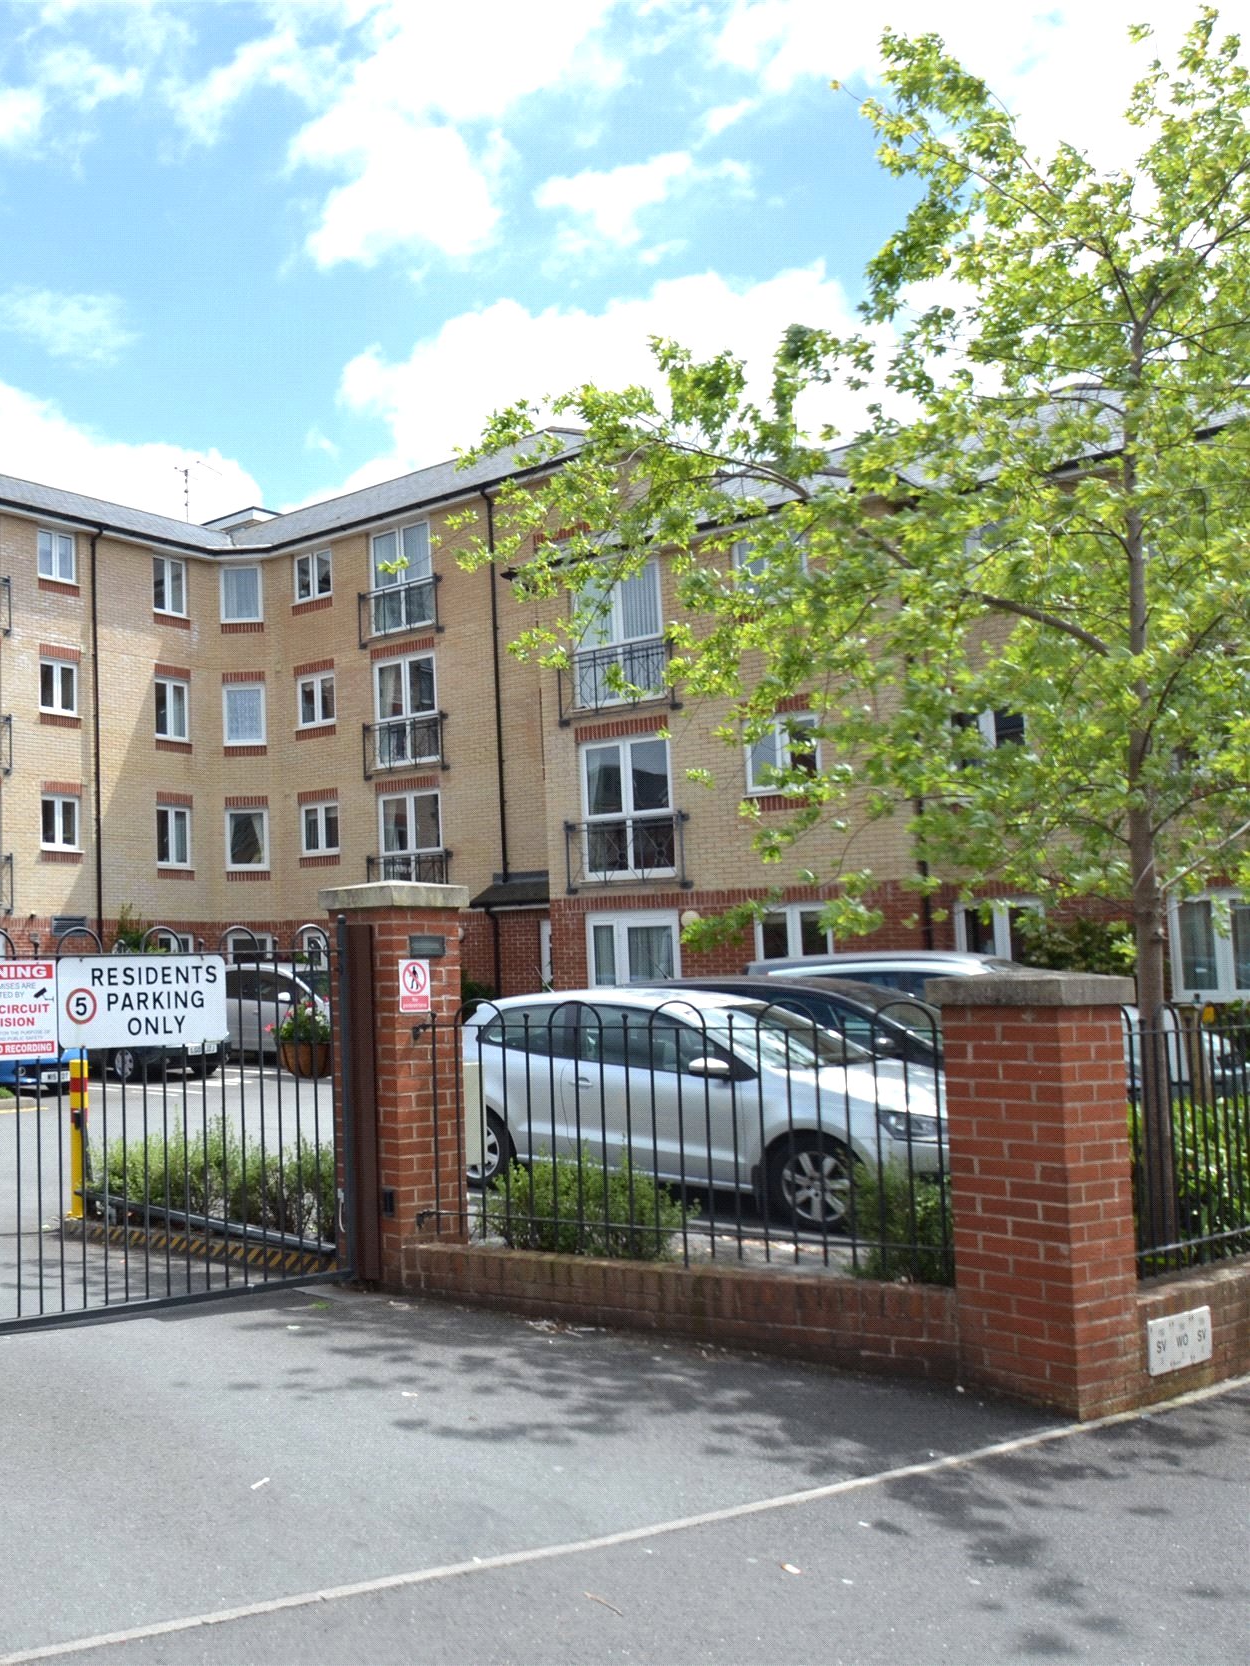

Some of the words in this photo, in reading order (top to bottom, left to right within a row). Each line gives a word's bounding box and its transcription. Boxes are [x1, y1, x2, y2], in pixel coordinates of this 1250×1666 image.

[91, 965, 217, 987] RESIDENTS
[75, 997, 87, 1016] 5
[107, 990, 204, 1011] PARKING
[127, 1015, 186, 1036] ONLY
[5, 1043, 52, 1053] RECORDING
[1197, 1328, 1207, 1342] SV
